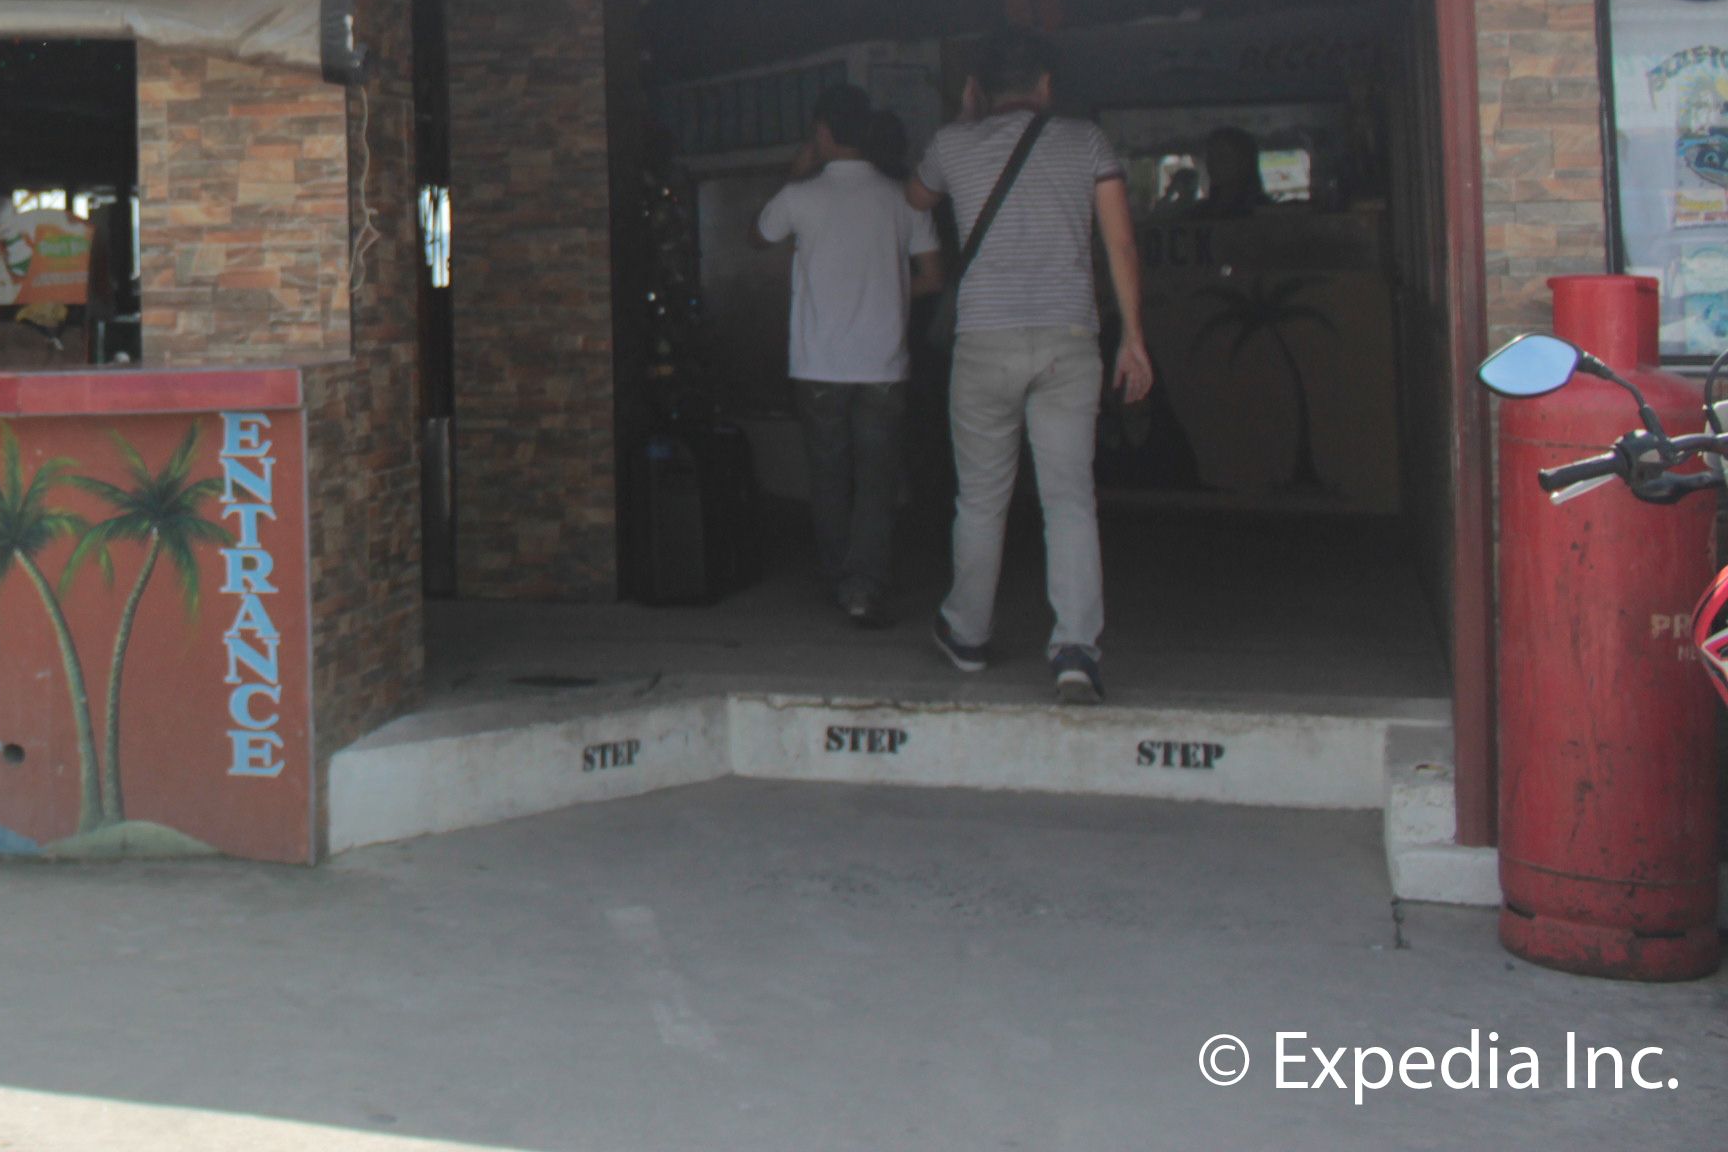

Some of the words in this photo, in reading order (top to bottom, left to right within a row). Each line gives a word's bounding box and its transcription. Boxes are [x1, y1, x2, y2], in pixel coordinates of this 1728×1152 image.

[218, 410, 286, 780] ENTRANCE
[582, 737, 641, 773] STEP
[824, 724, 909, 756] STEP
[1136, 738, 1225, 770] STEP
